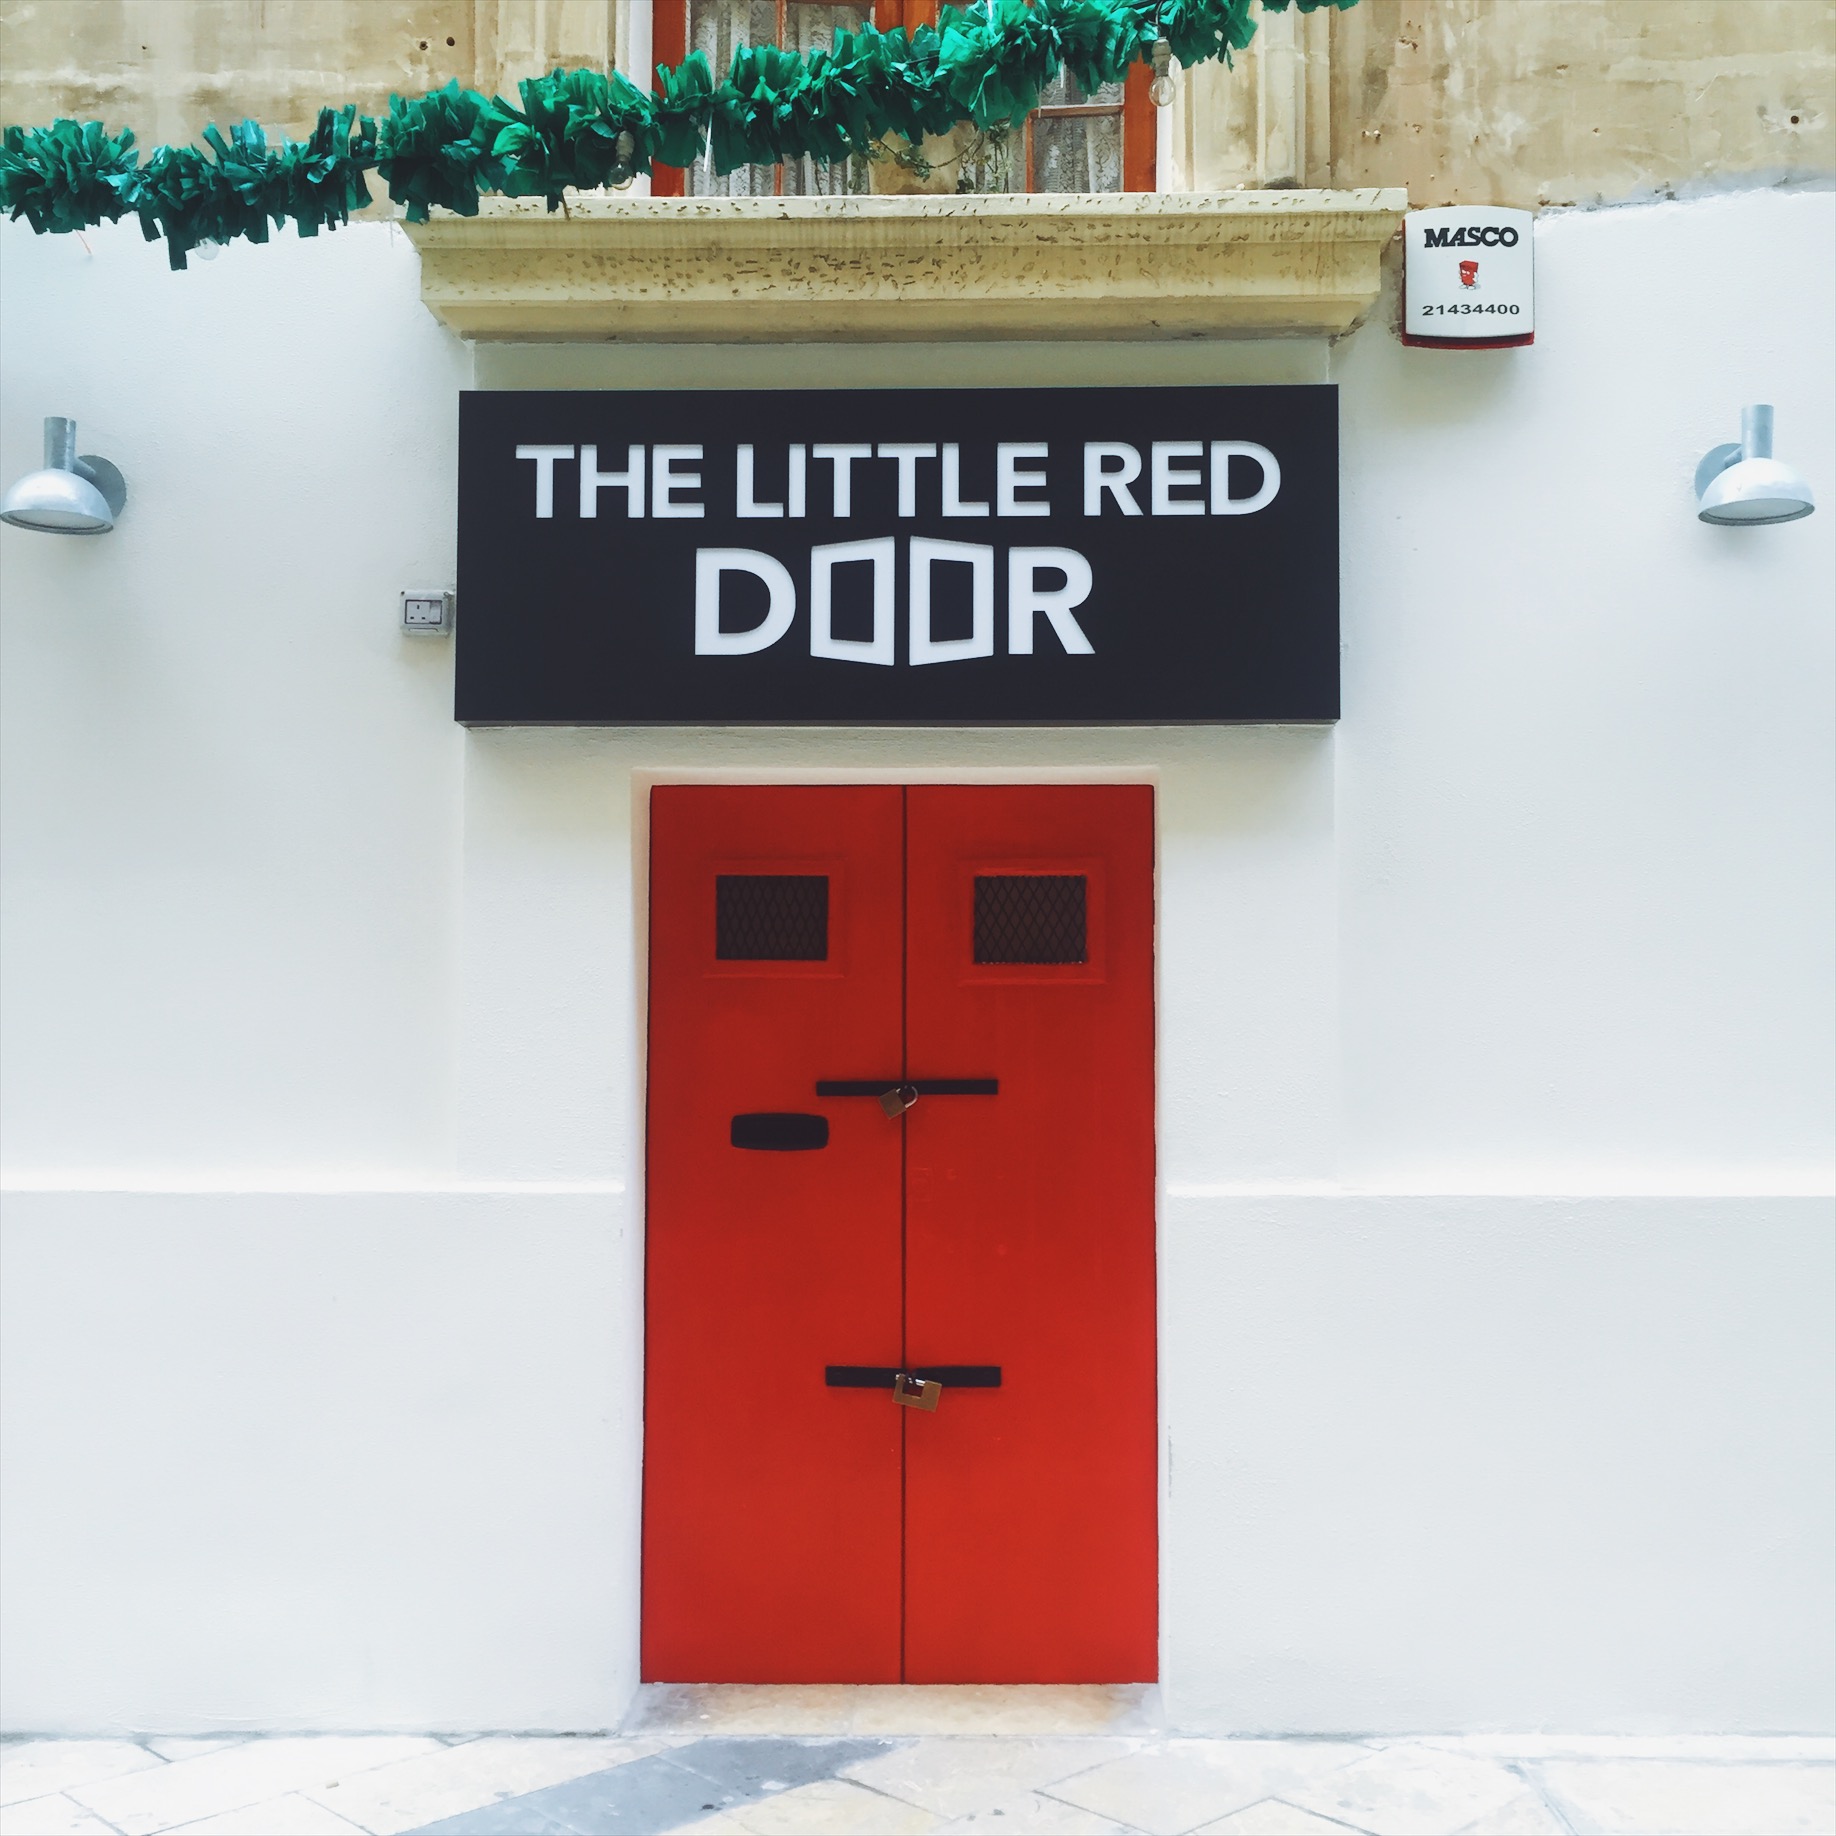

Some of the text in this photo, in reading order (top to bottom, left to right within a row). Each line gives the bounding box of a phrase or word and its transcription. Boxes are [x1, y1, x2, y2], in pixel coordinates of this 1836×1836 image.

[1424, 227, 1518, 248] MASCO
[1423, 304, 1519, 316] 21434400
[516, 441, 1280, 518] THE LITTLE RED
[695, 536, 1095, 666] DOOR
